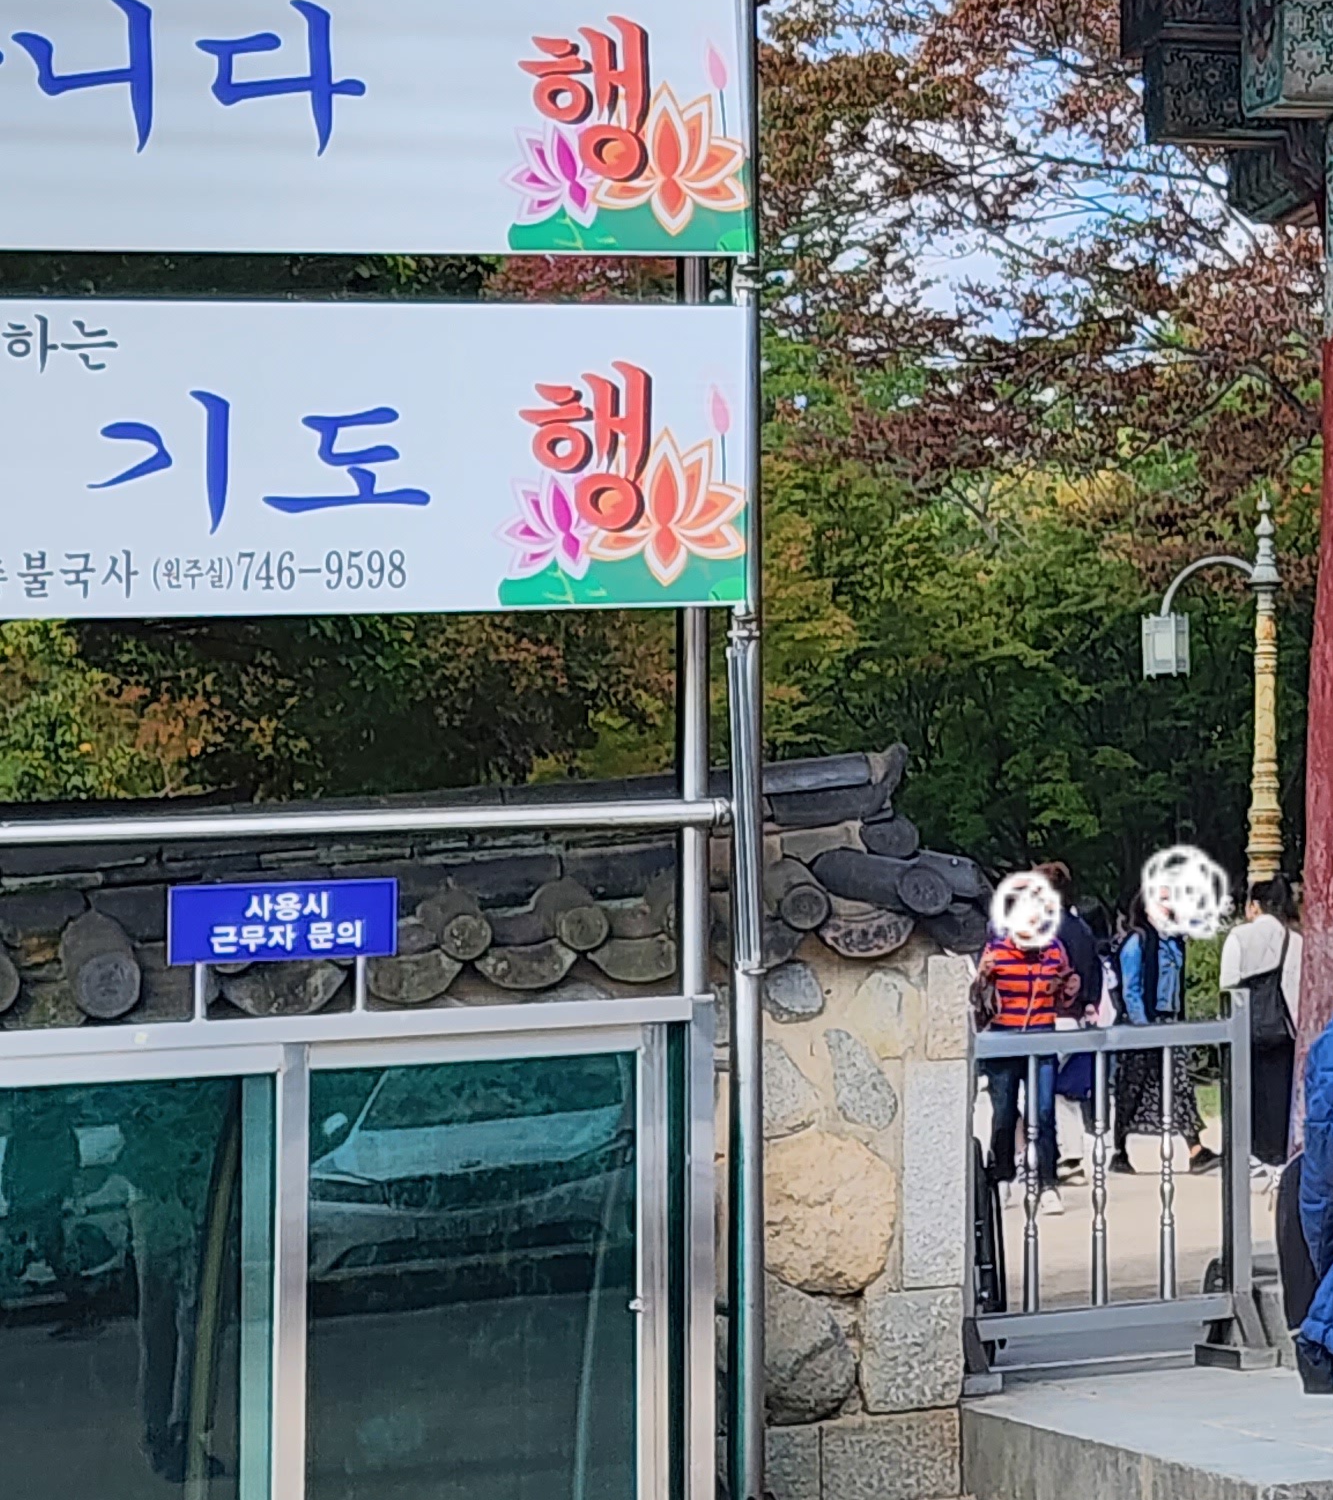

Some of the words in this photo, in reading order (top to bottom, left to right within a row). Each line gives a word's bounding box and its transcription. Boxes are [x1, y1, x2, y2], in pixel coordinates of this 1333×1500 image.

[518, 15, 651, 182] 행
[1, 313, 119, 374] 하는
[86, 390, 431, 535] 기도
[518, 360, 652, 533] 행
[16, 549, 139, 599] 불국사
[210, 923, 297, 953] 근무자
[307, 919, 364, 949] 문의
[244, 891, 330, 922] 사용시
